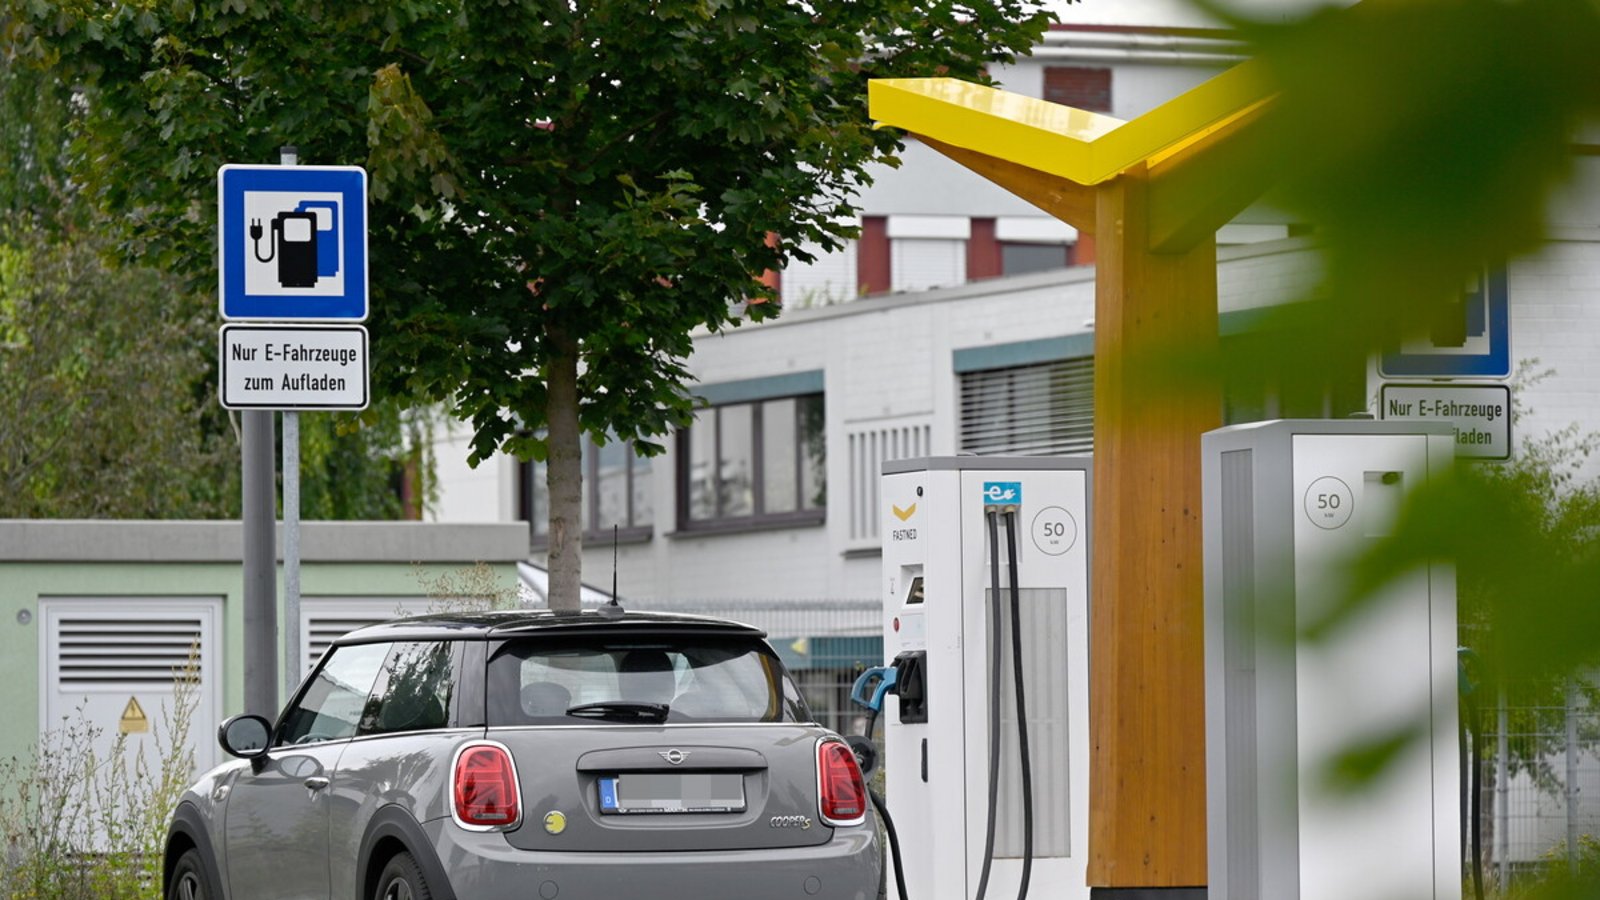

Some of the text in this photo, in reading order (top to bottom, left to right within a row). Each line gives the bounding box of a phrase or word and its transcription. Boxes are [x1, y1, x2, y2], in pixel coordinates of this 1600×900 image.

[232, 343, 357, 367] Nur E-Fahrzeuge
[244, 373, 346, 391] zum Aufladen
[1389, 399, 1502, 422] Nur E-Fahrzeuge
[1452, 427, 1492, 445] laden
[1318, 494, 1340, 509] 50
[892, 528, 917, 541] FASTNED
[1044, 522, 1065, 537] 50
